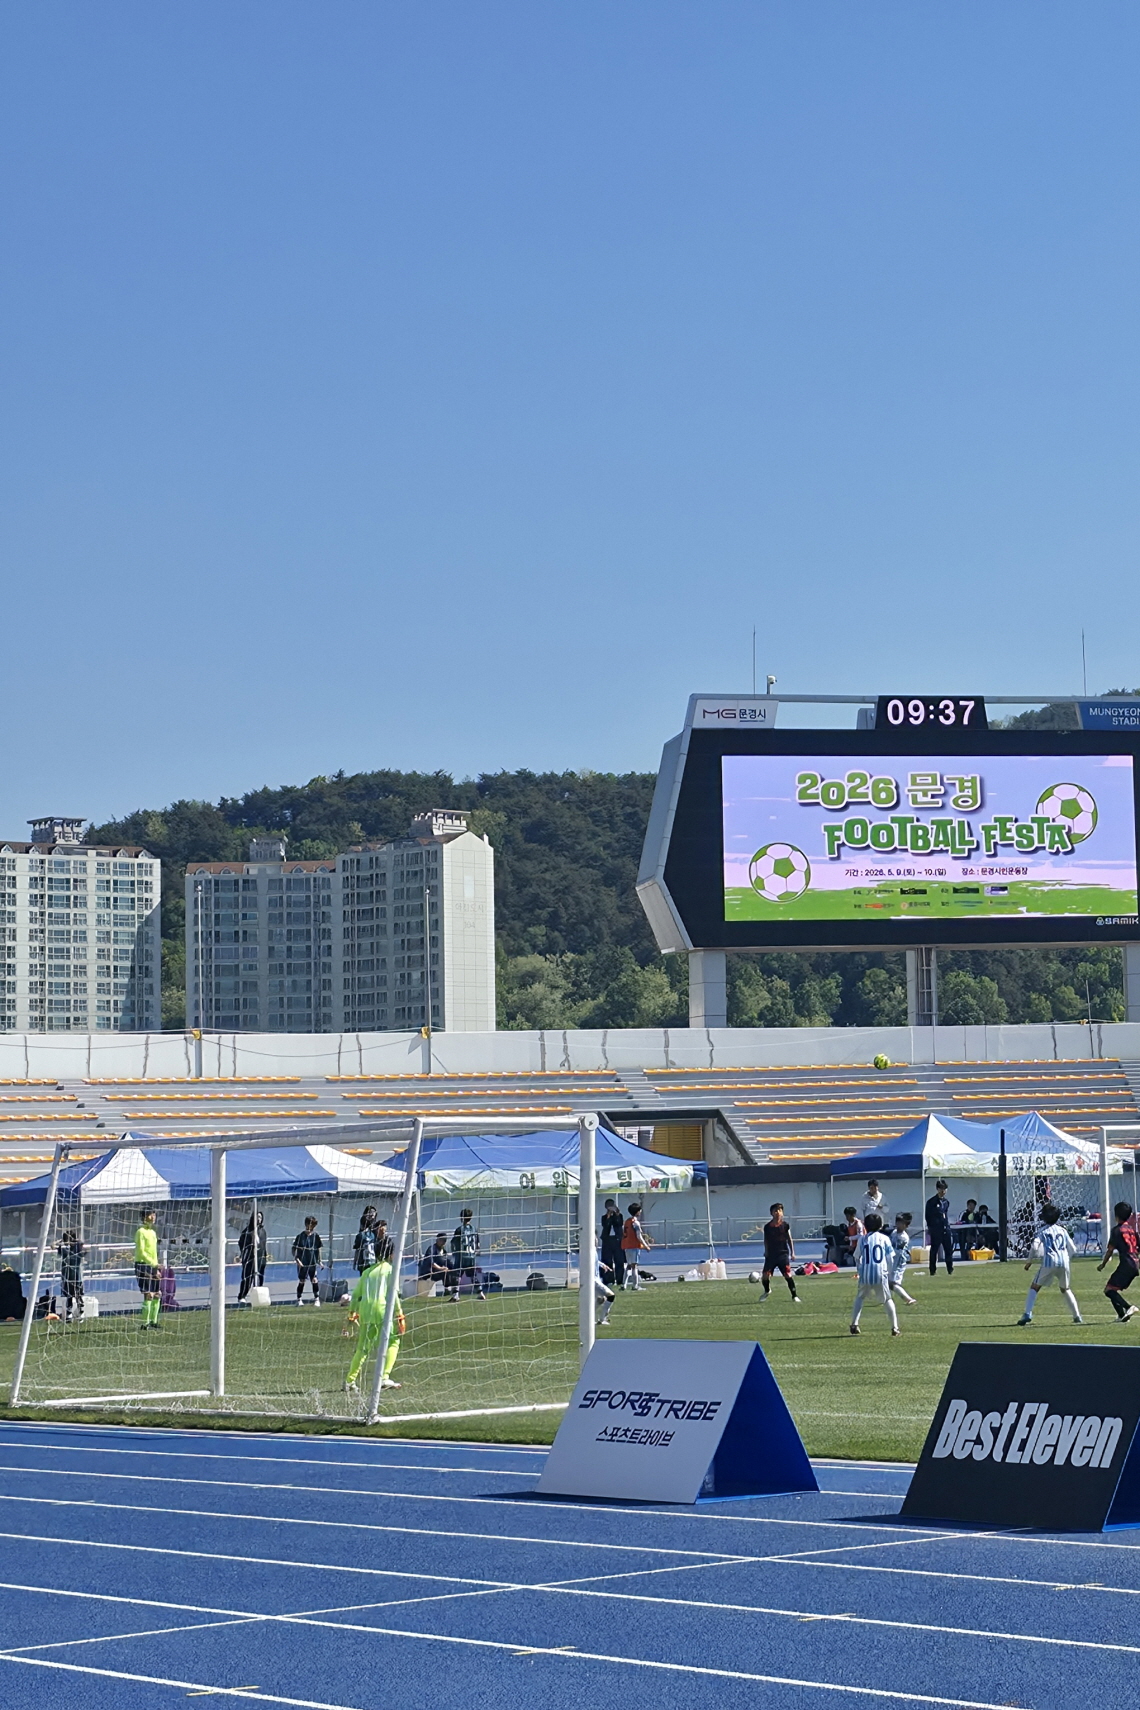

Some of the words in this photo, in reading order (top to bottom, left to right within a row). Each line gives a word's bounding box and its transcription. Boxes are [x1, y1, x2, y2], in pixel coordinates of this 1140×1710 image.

[702, 708, 737, 719] MG
[738, 708, 767, 719] 문경시
[886, 699, 976, 726] 09:37
[796, 771, 897, 809] 2026
[906, 771, 981, 811] 문경
[822, 815, 977, 858] FOOTBALL
[981, 815, 1073, 856] FESTA
[961, 867, 976, 877] 장소
[1104, 917, 1140, 925] SAMIK
[862, 1244, 884, 1265] 10
[595, 1425, 676, 1447] 스포츠트라이브
